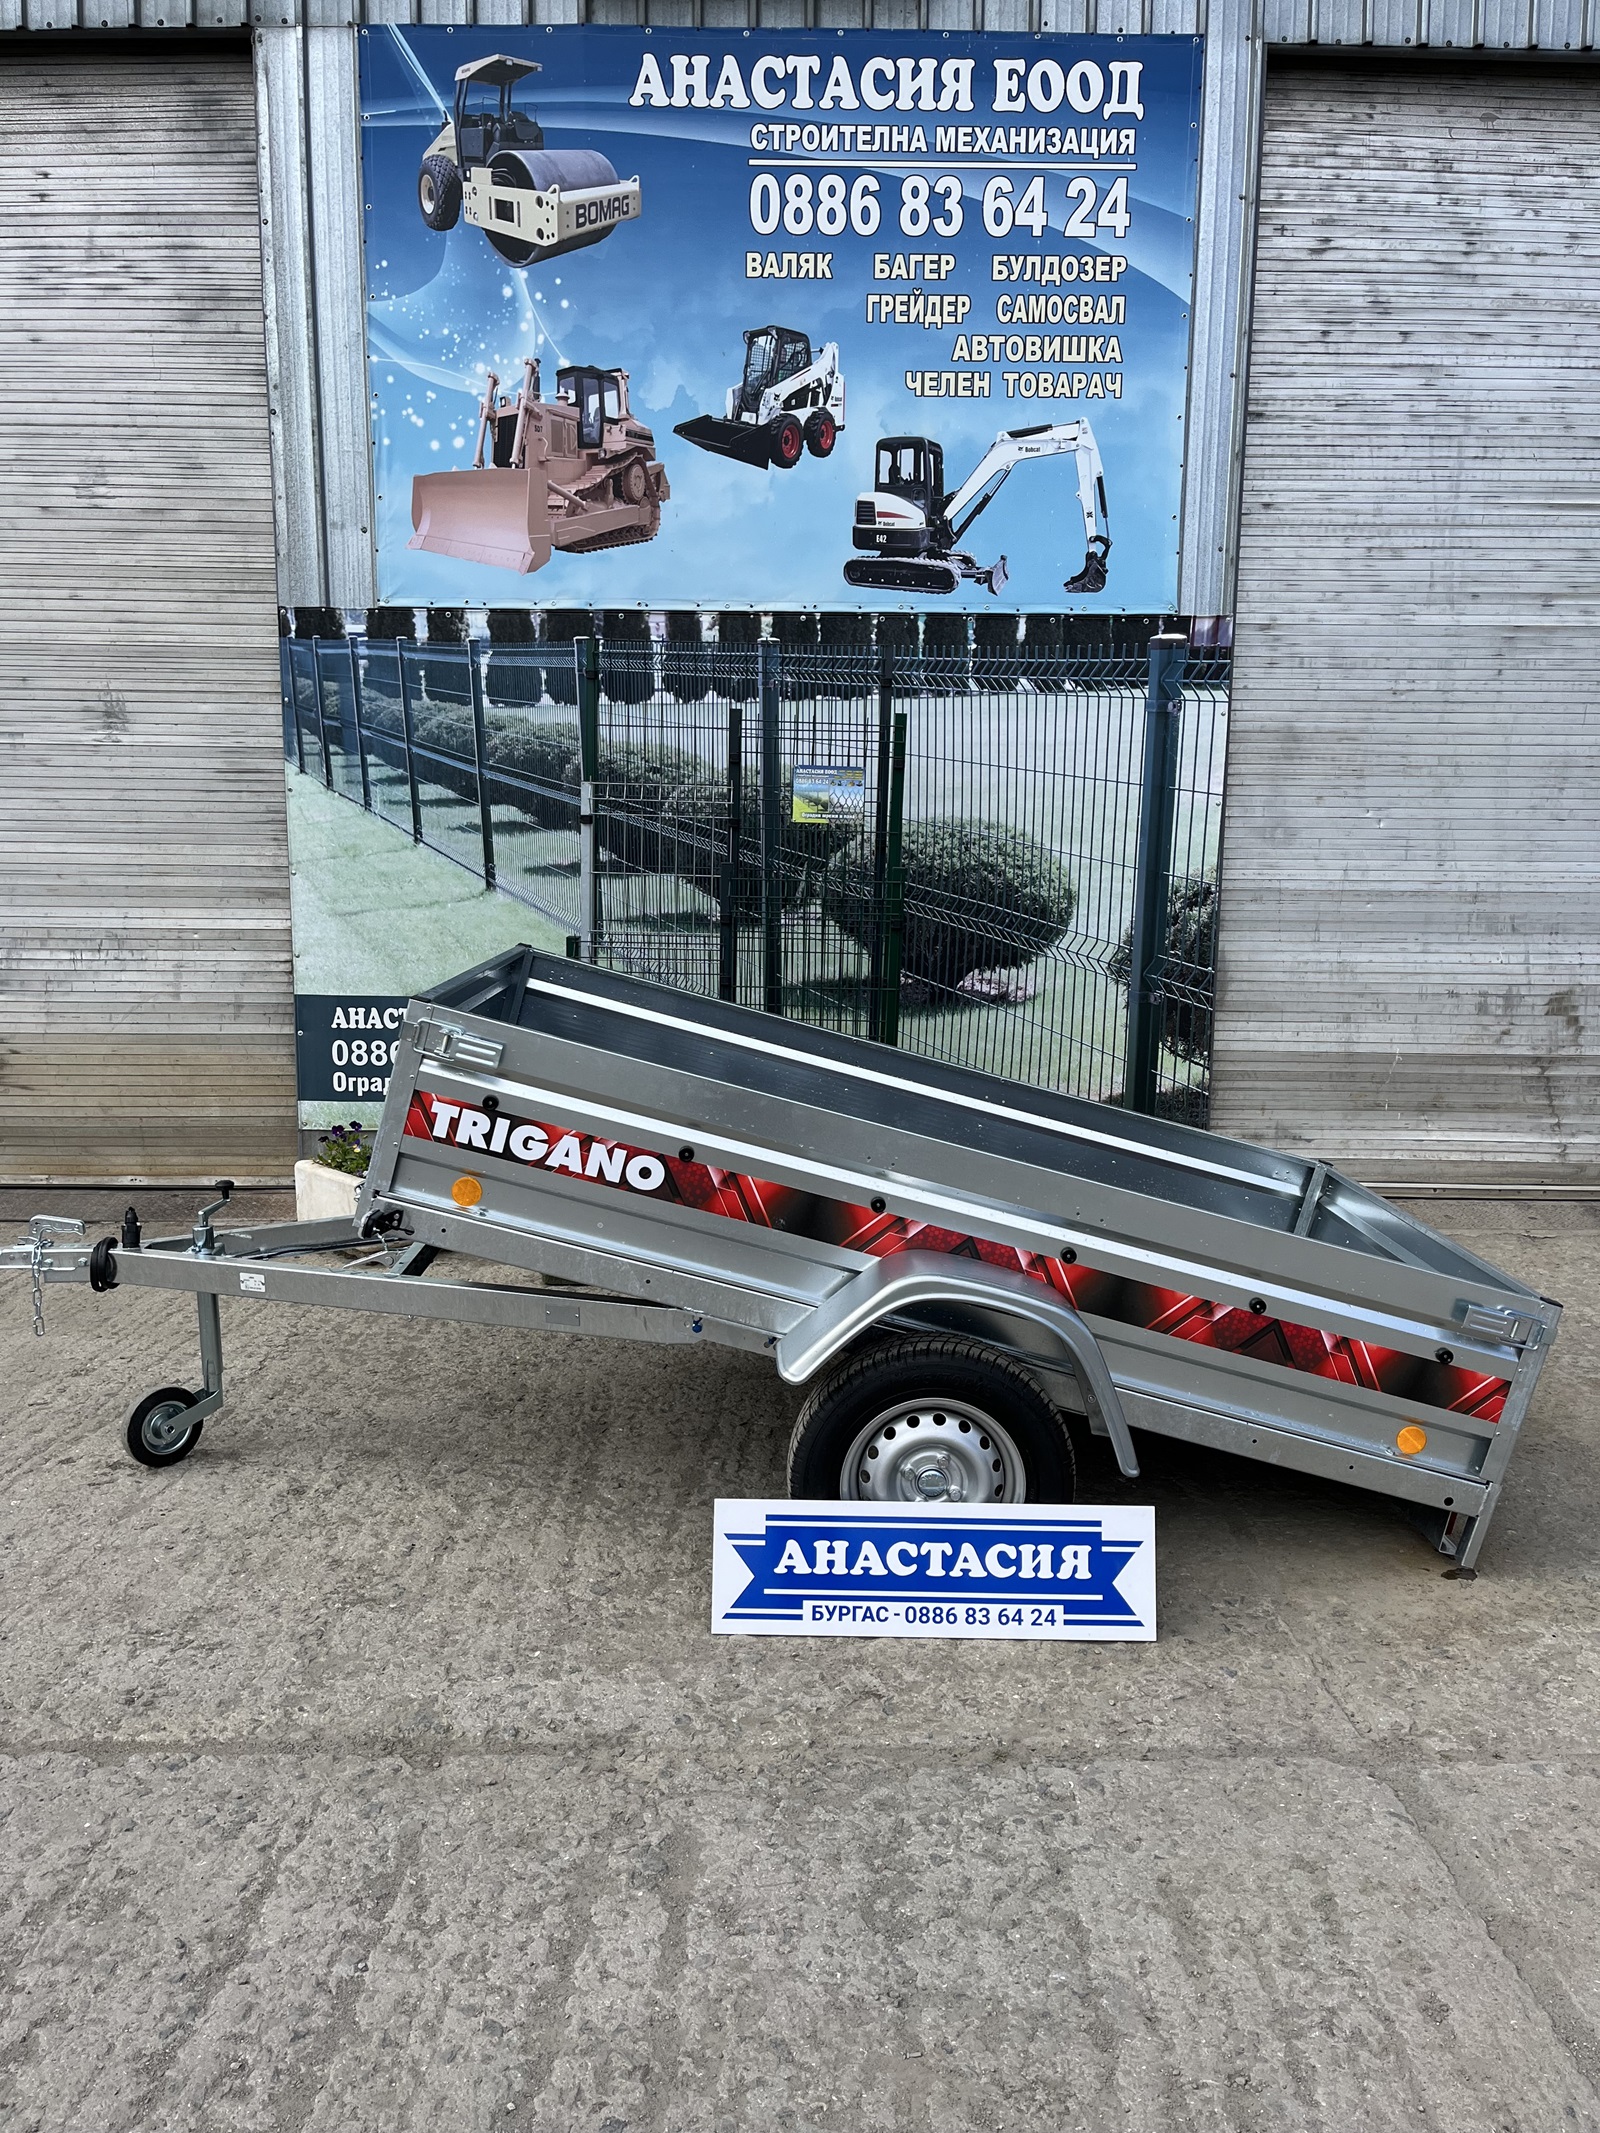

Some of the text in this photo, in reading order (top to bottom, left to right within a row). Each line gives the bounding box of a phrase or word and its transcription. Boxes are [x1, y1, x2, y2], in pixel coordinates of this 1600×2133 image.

[629, 53, 1144, 120] АНАСТАСИЯ ЕООД
[751, 124, 1136, 159] СТРОИТЕЛНА МЕХАНИЗАЦИЯ
[575, 194, 630, 230] BOMAG
[750, 173, 1130, 238] 0886 83 64 24
[746, 252, 1127, 282] ВАЛЯК БАГЕР БУЛДОЗЕР
[867, 289, 1125, 328] ГРЕЙДЕР САМОСВАЛ
[952, 335, 1122, 362] АВТОВИШКА
[906, 372, 1122, 398] ЧЕЛЕН ТОВАРАЧ
[876, 534, 887, 543] E42
[431, 1100, 665, 1191] TRIGANO
[773, 1539, 1092, 1580] АНАСТАСИЯ
[811, 1605, 889, 1623] БУРГАС
[904, 1606, 958, 1625] 0886
[964, 1607, 991, 1626] 83
[998, 1608, 1024, 1626] 64
[1030, 1609, 1057, 1627] 24
